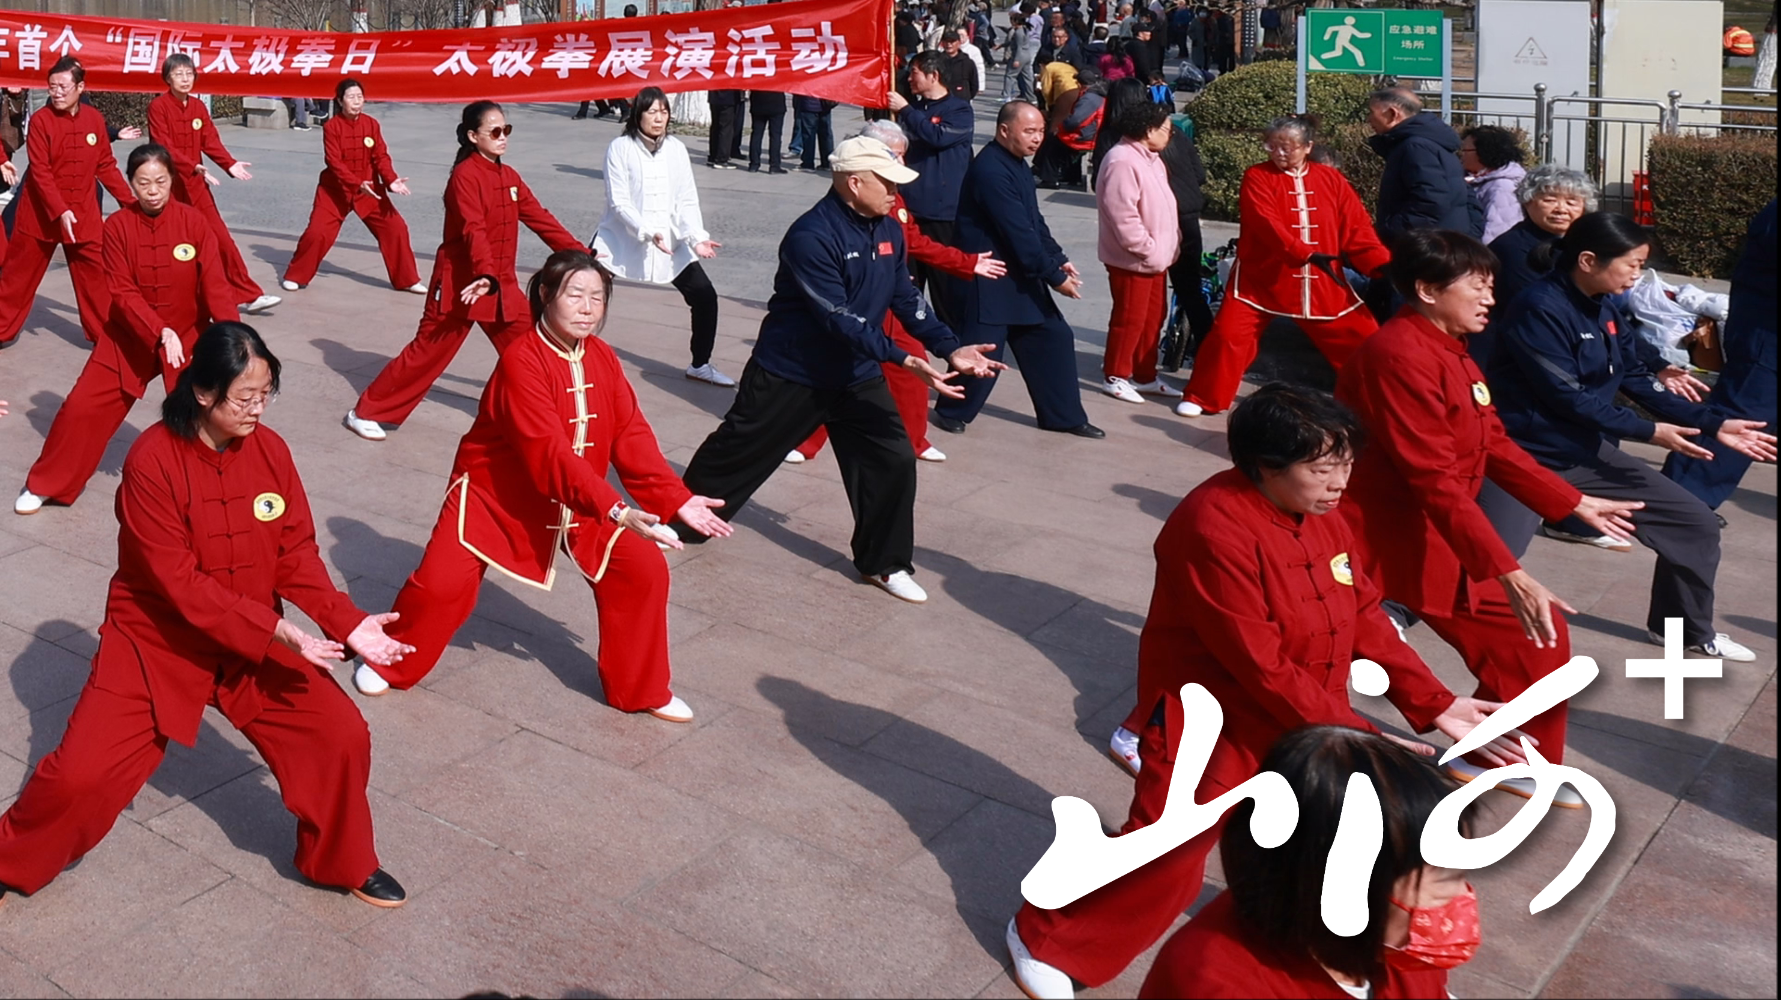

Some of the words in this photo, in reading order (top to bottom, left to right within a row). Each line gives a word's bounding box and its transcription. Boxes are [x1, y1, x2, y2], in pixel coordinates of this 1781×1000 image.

[1388, 24, 1438, 35] 应急避难
[1400, 39, 1425, 50] 场所
[431, 21, 850, 81] 太极拳展演活动
